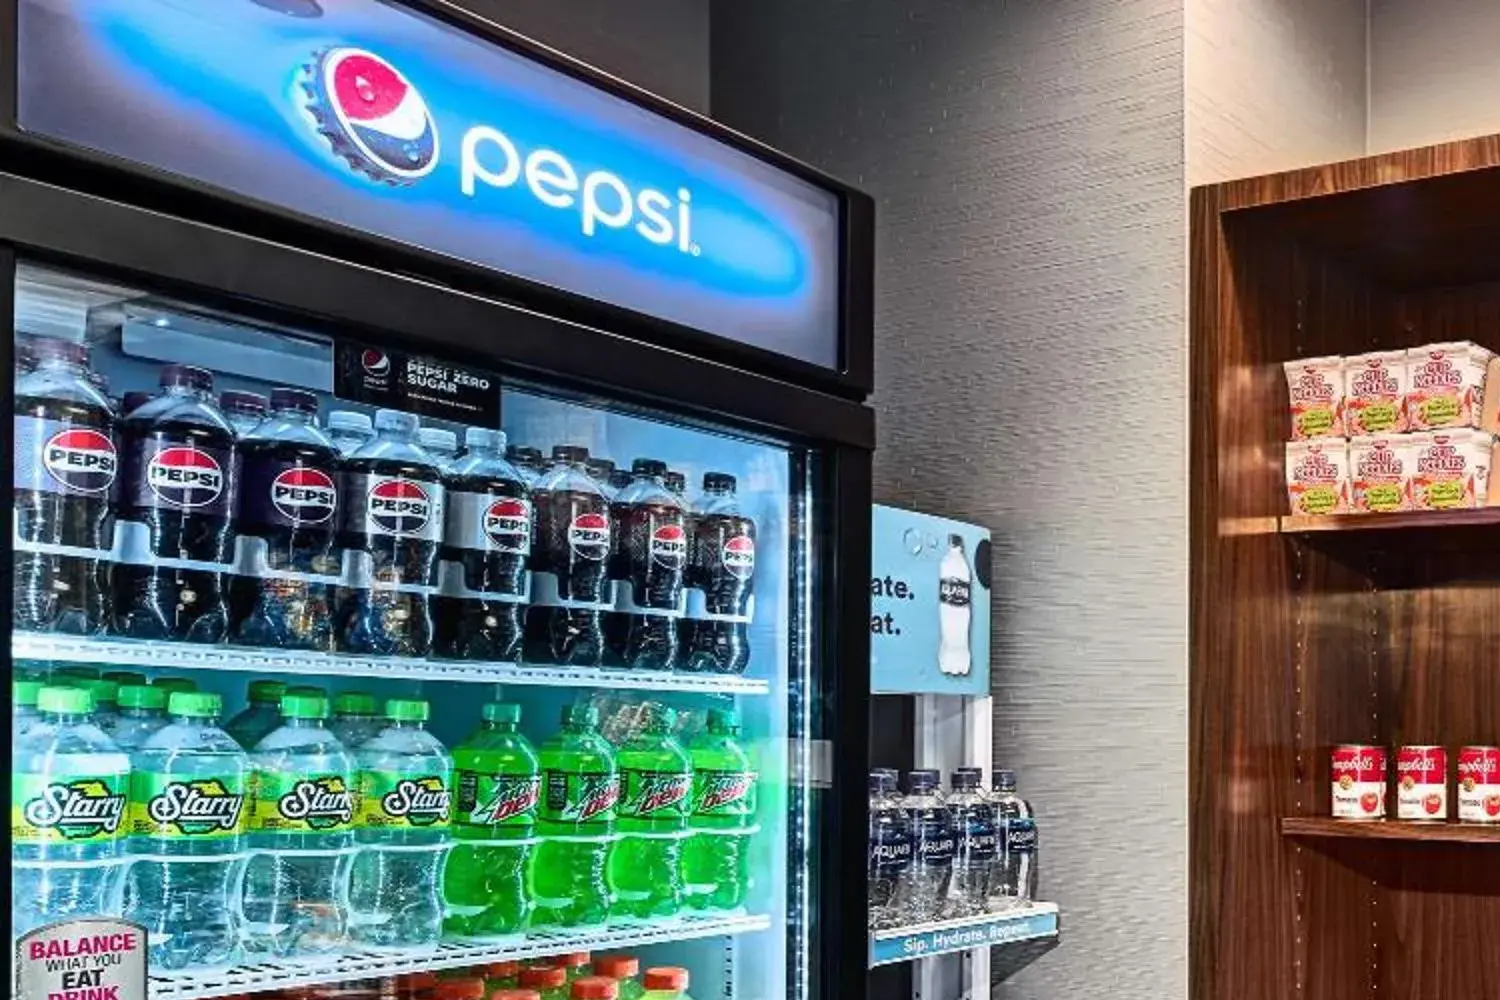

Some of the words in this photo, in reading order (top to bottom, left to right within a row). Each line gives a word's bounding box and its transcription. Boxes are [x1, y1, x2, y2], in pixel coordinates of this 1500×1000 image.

[461, 126, 691, 254] pepsi
[407, 360, 448, 380] PEPSI
[453, 370, 490, 390] ZERO
[407, 374, 457, 393] SUGAR
[151, 466, 220, 487] PEPSI
[275, 487, 334, 505] PEPSI
[371, 498, 427, 517] PEPSI
[872, 612, 901, 636] at.
[27, 781, 126, 832] Starry
[149, 781, 242, 833] Starry
[30, 934, 137, 960] BALANCE
[904, 938, 928, 954] Sip.
[933, 929, 986, 947] Hydrate.
[46, 955, 89, 972] WHAT
[95, 953, 121, 967] YOU
[62, 969, 105, 990] EAT
